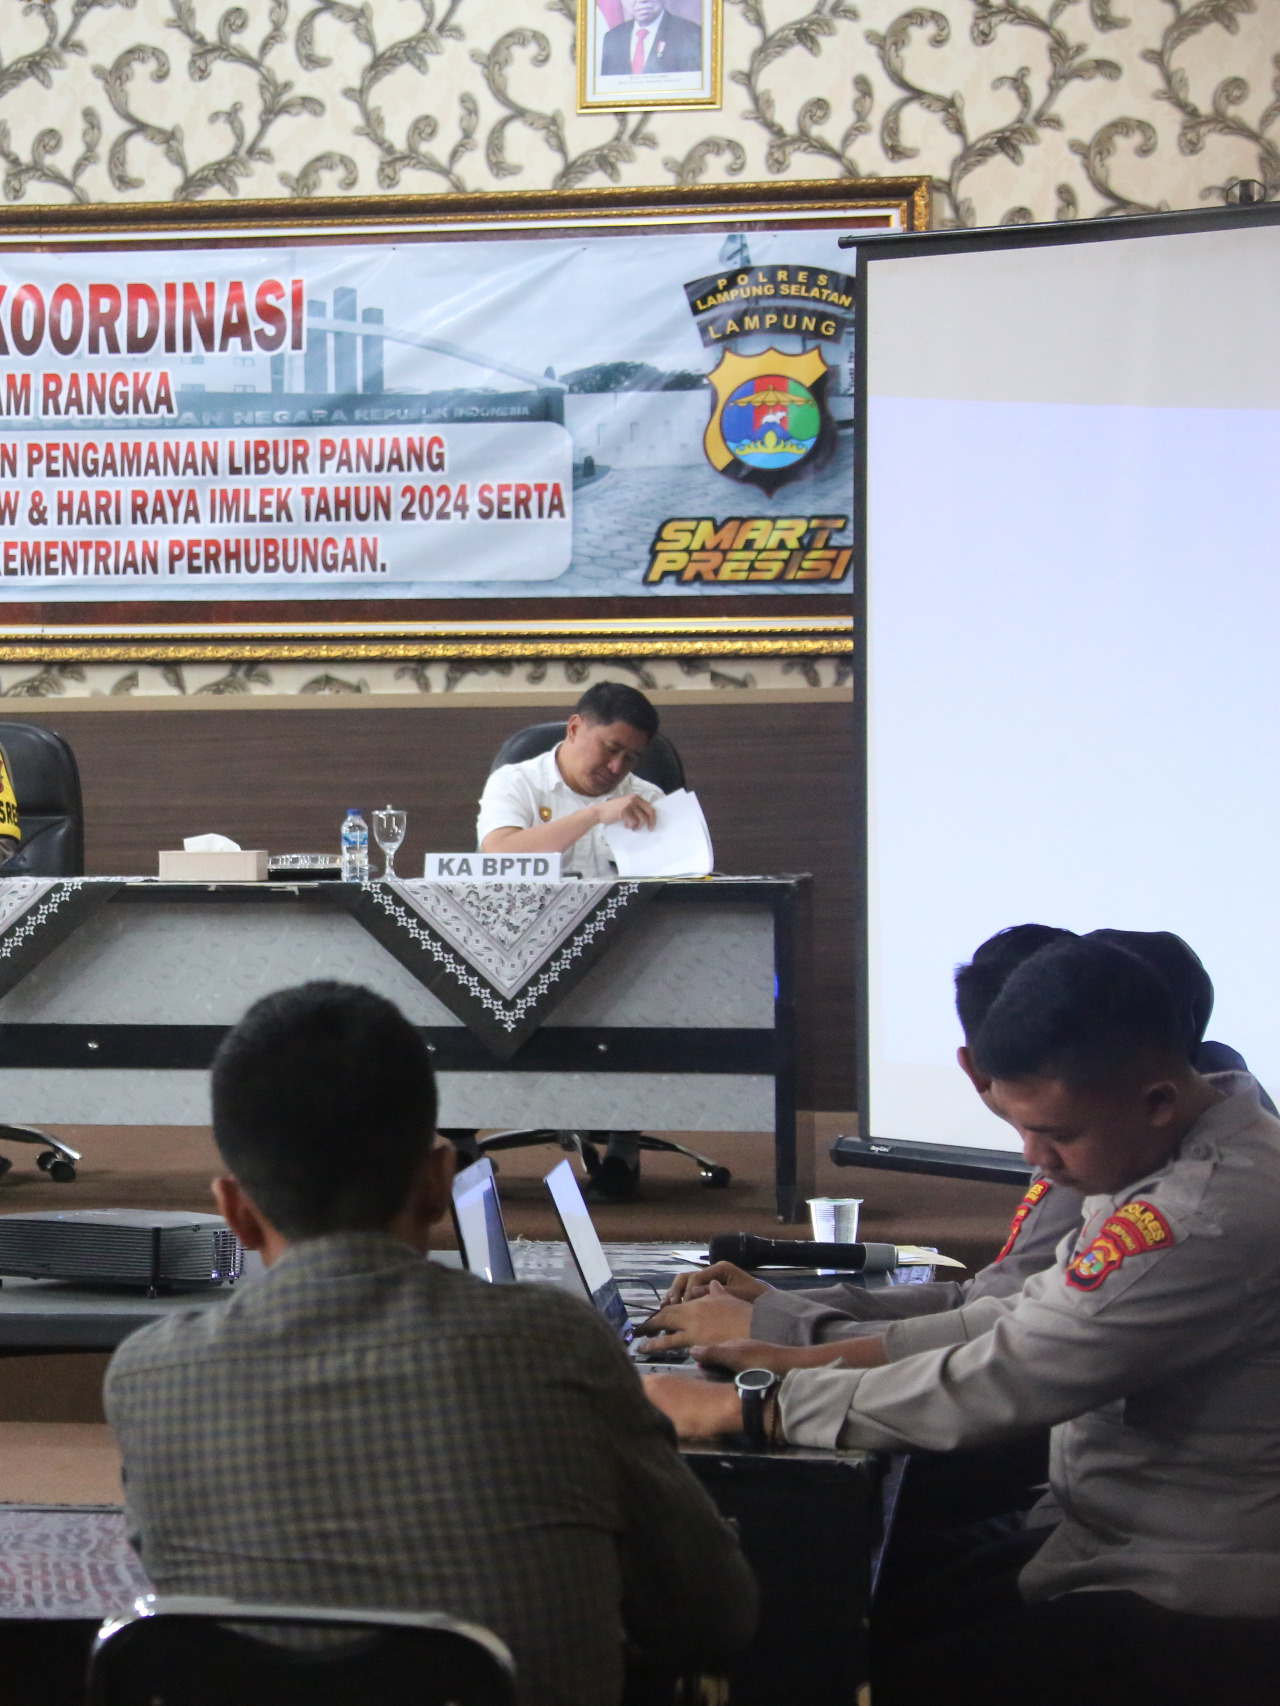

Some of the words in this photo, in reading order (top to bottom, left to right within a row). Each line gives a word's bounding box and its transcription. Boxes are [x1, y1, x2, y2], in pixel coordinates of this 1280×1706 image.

[717, 270, 828, 290] POLRES
[696, 284, 775, 311] LAMPUNG
[779, 284, 853, 308] SELATAN
[708, 314, 837, 340] LAMPUNG
[42, 371, 174, 416] RANGKA
[27, 441, 218, 478] PENGAMANAN
[229, 439, 309, 476] LIBUR
[320, 435, 445, 474] PANJANG
[28, 490, 48, 526] &
[57, 489, 120, 525] HARI
[131, 489, 200, 525] RAYA
[210, 487, 293, 524] IMLEK
[301, 486, 391, 522] TAHUN
[401, 484, 470, 521] 2024
[477, 483, 566, 520] SERTA
[654, 517, 848, 551] SMART
[169, 537, 387, 574] PERHUBUNGAN.
[646, 549, 854, 582] PRESISI
[437, 858, 474, 877] KA
[481, 858, 550, 877] BPTD
